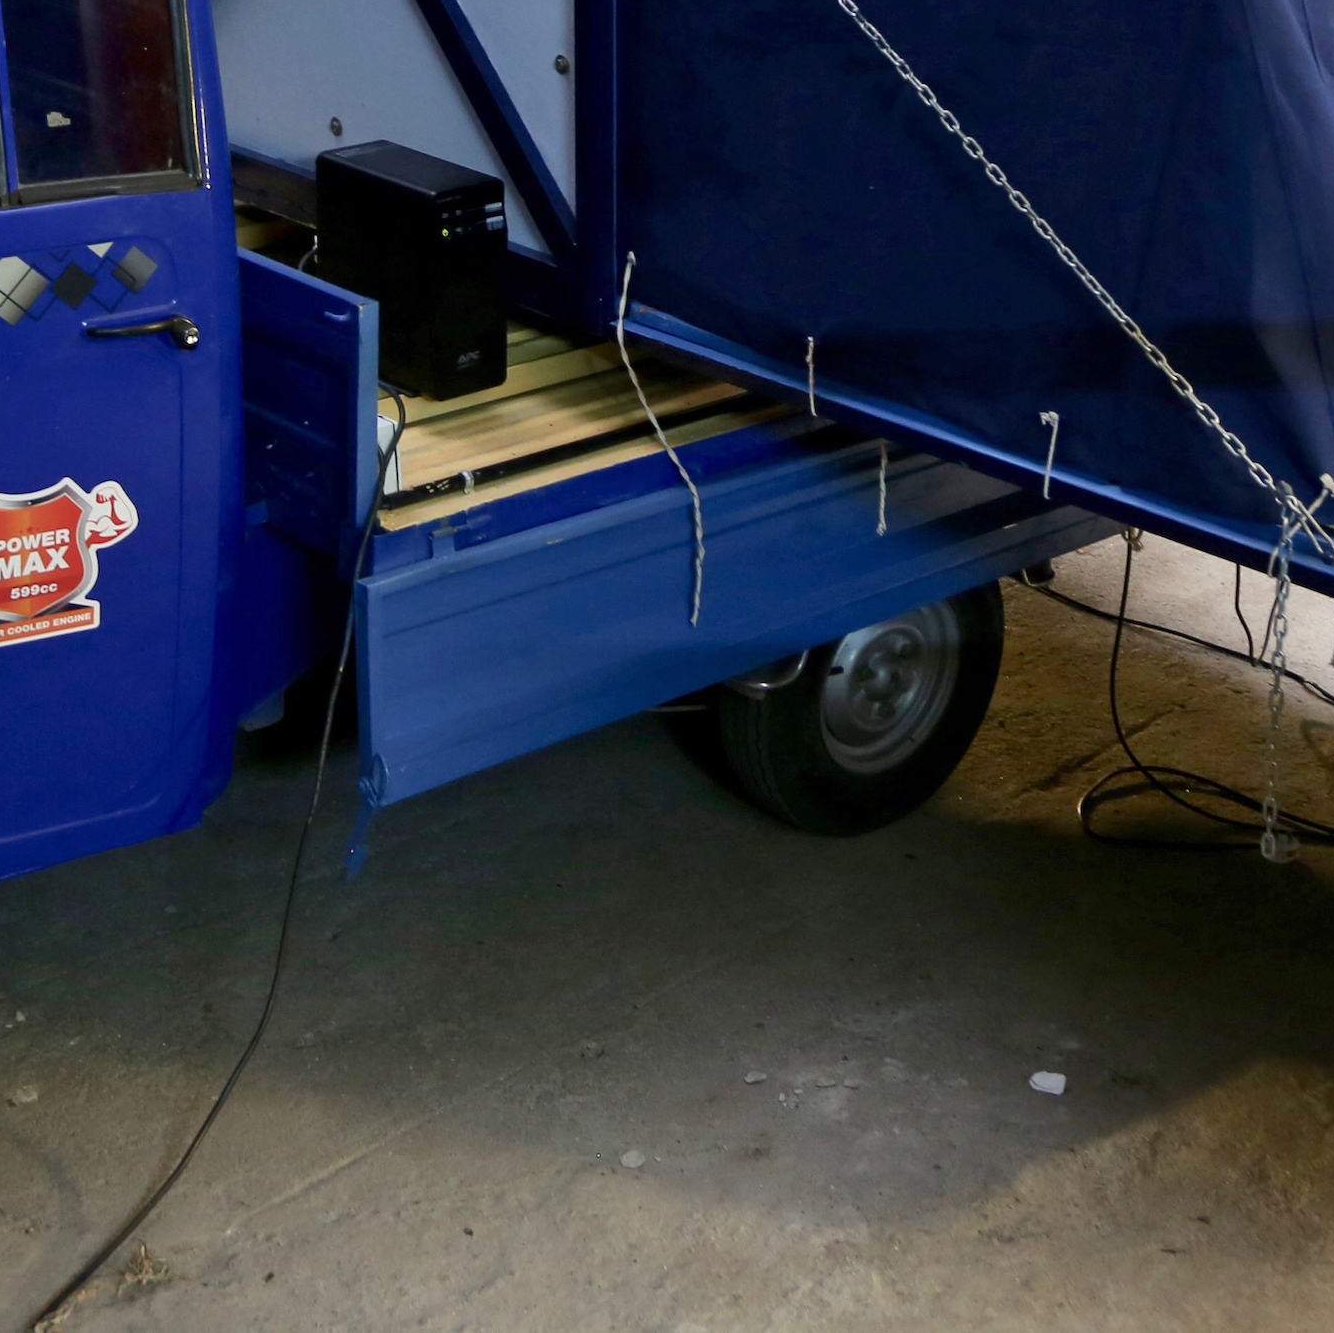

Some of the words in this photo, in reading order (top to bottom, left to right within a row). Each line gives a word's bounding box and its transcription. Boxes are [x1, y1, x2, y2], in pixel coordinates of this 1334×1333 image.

[10, 583, 58, 600] 599cc
[7, 620, 50, 635] COOLED
[53, 612, 92, 627] ENGINE
